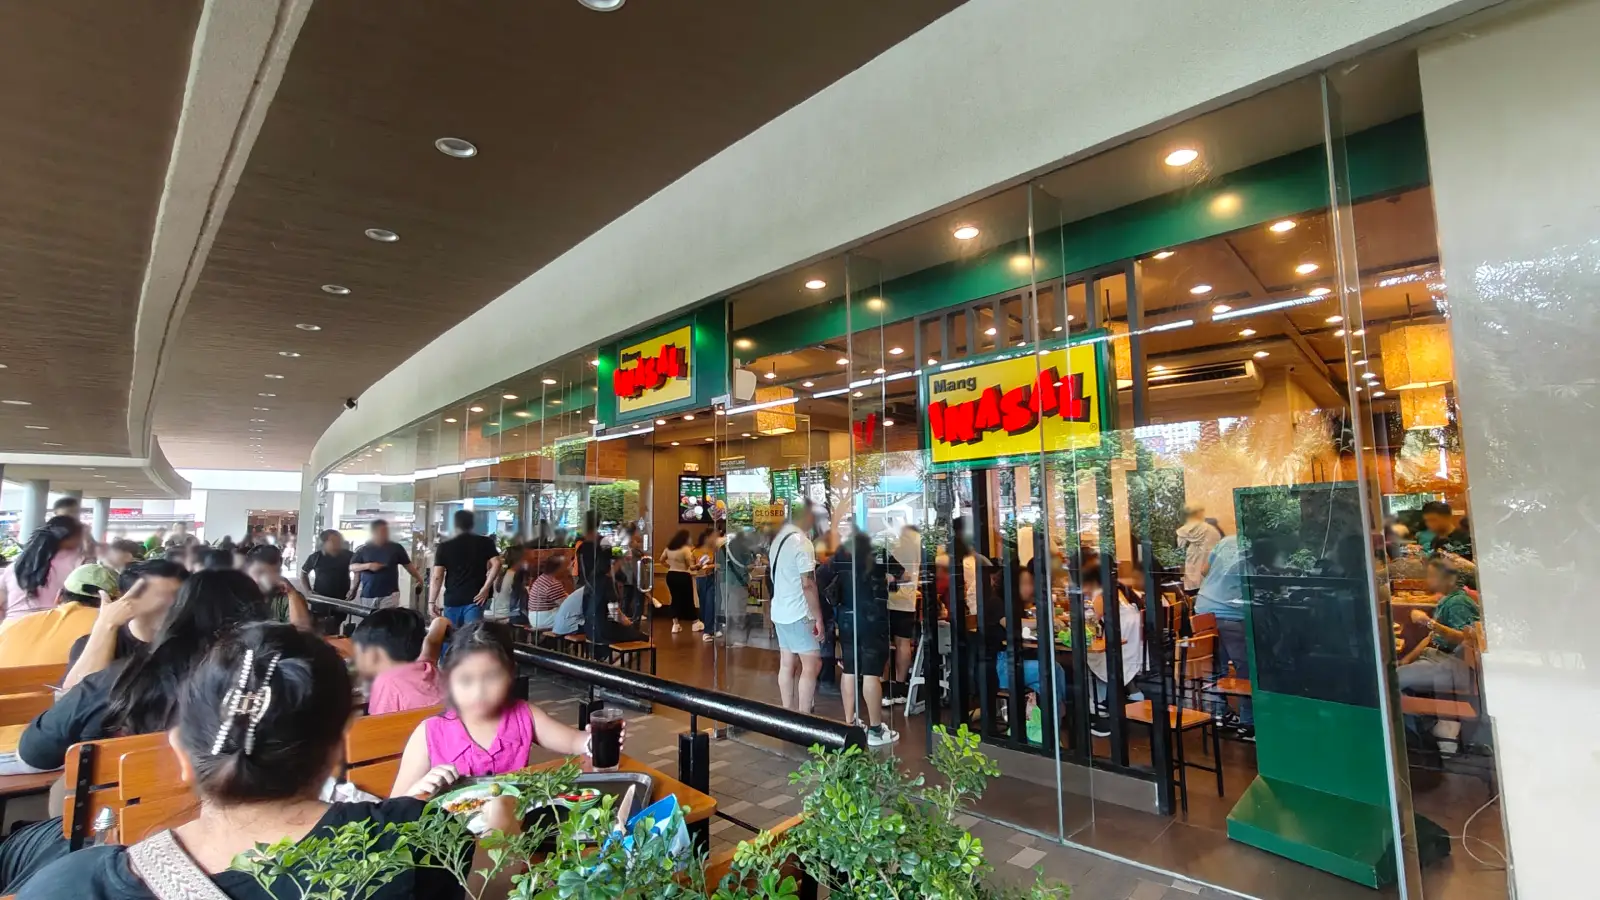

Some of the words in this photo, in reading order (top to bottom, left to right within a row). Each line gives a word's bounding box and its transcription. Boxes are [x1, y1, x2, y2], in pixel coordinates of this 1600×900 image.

[933, 376, 977, 394] Mang
[928, 366, 1091, 447] INASAL
[754, 509, 784, 517] CLOSED
